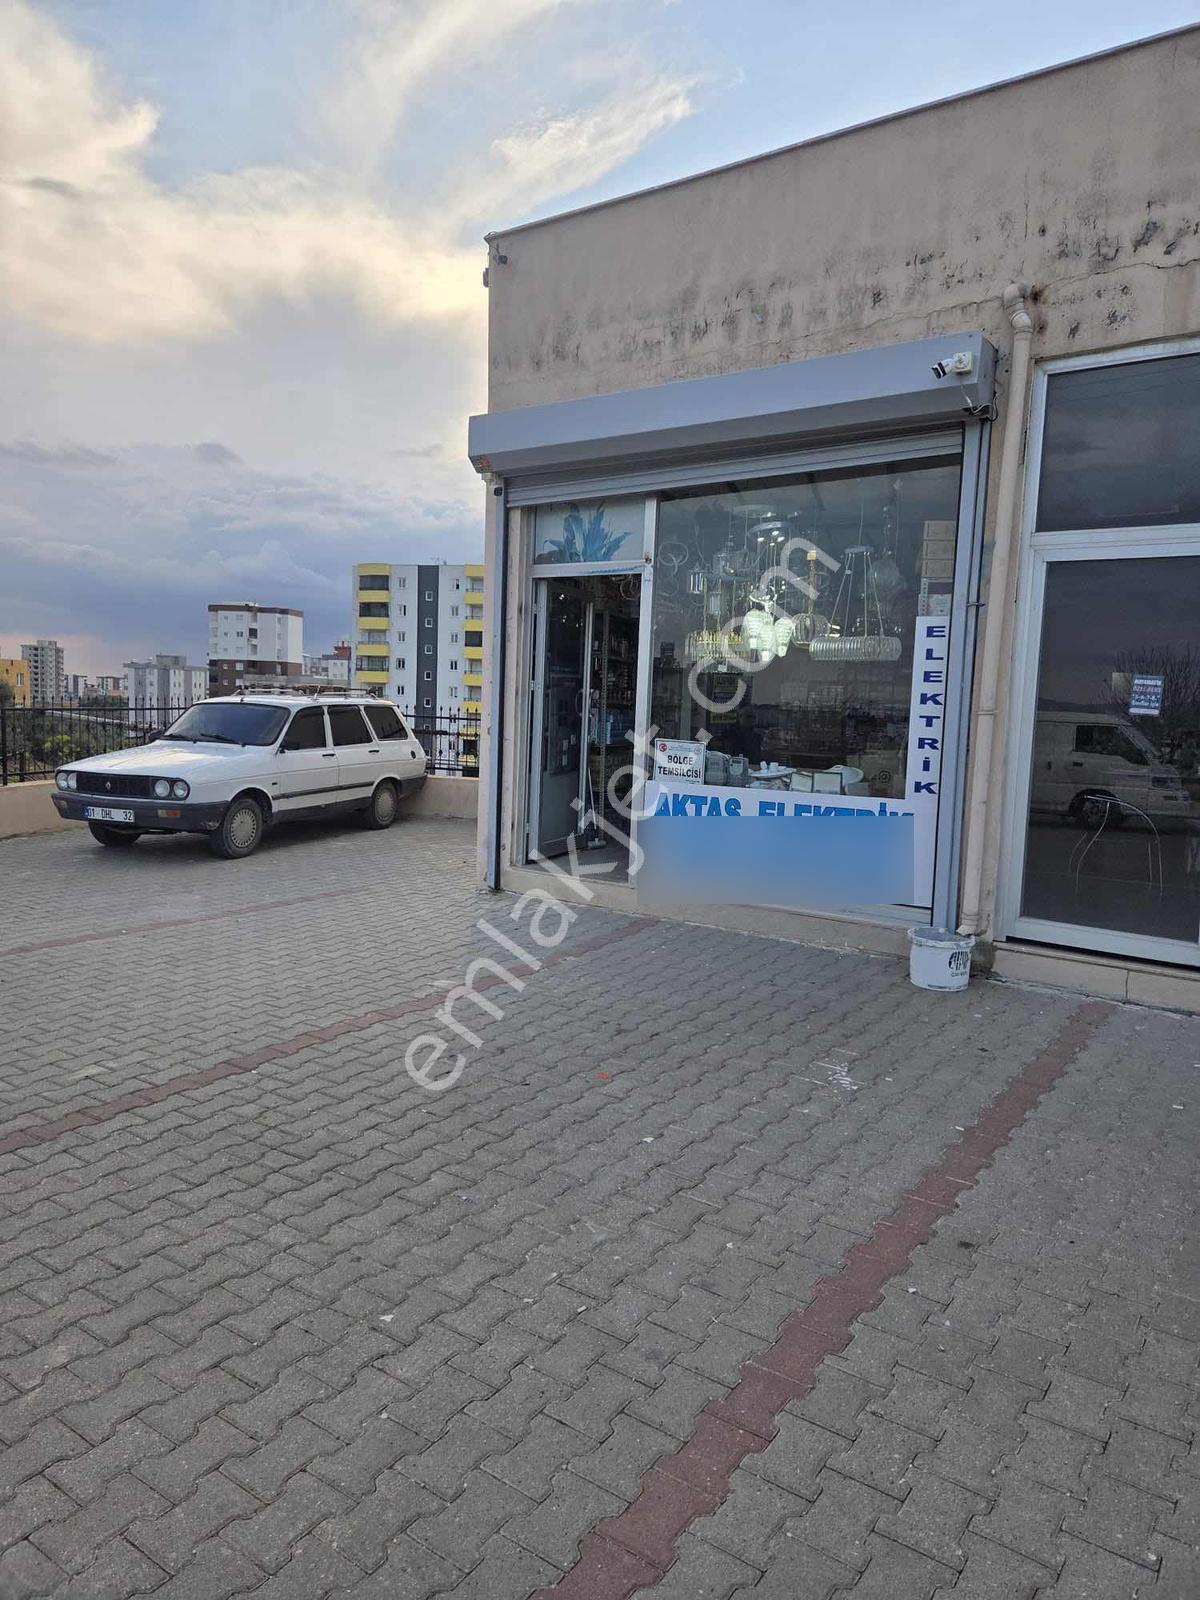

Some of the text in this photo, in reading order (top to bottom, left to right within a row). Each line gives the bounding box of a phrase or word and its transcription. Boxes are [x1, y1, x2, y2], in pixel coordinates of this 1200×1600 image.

[914, 625, 946, 795] ELEKTRİK
[667, 754, 694, 766] BÖLGE
[102, 809, 115, 820] DHL
[123, 811, 133, 821] 32
